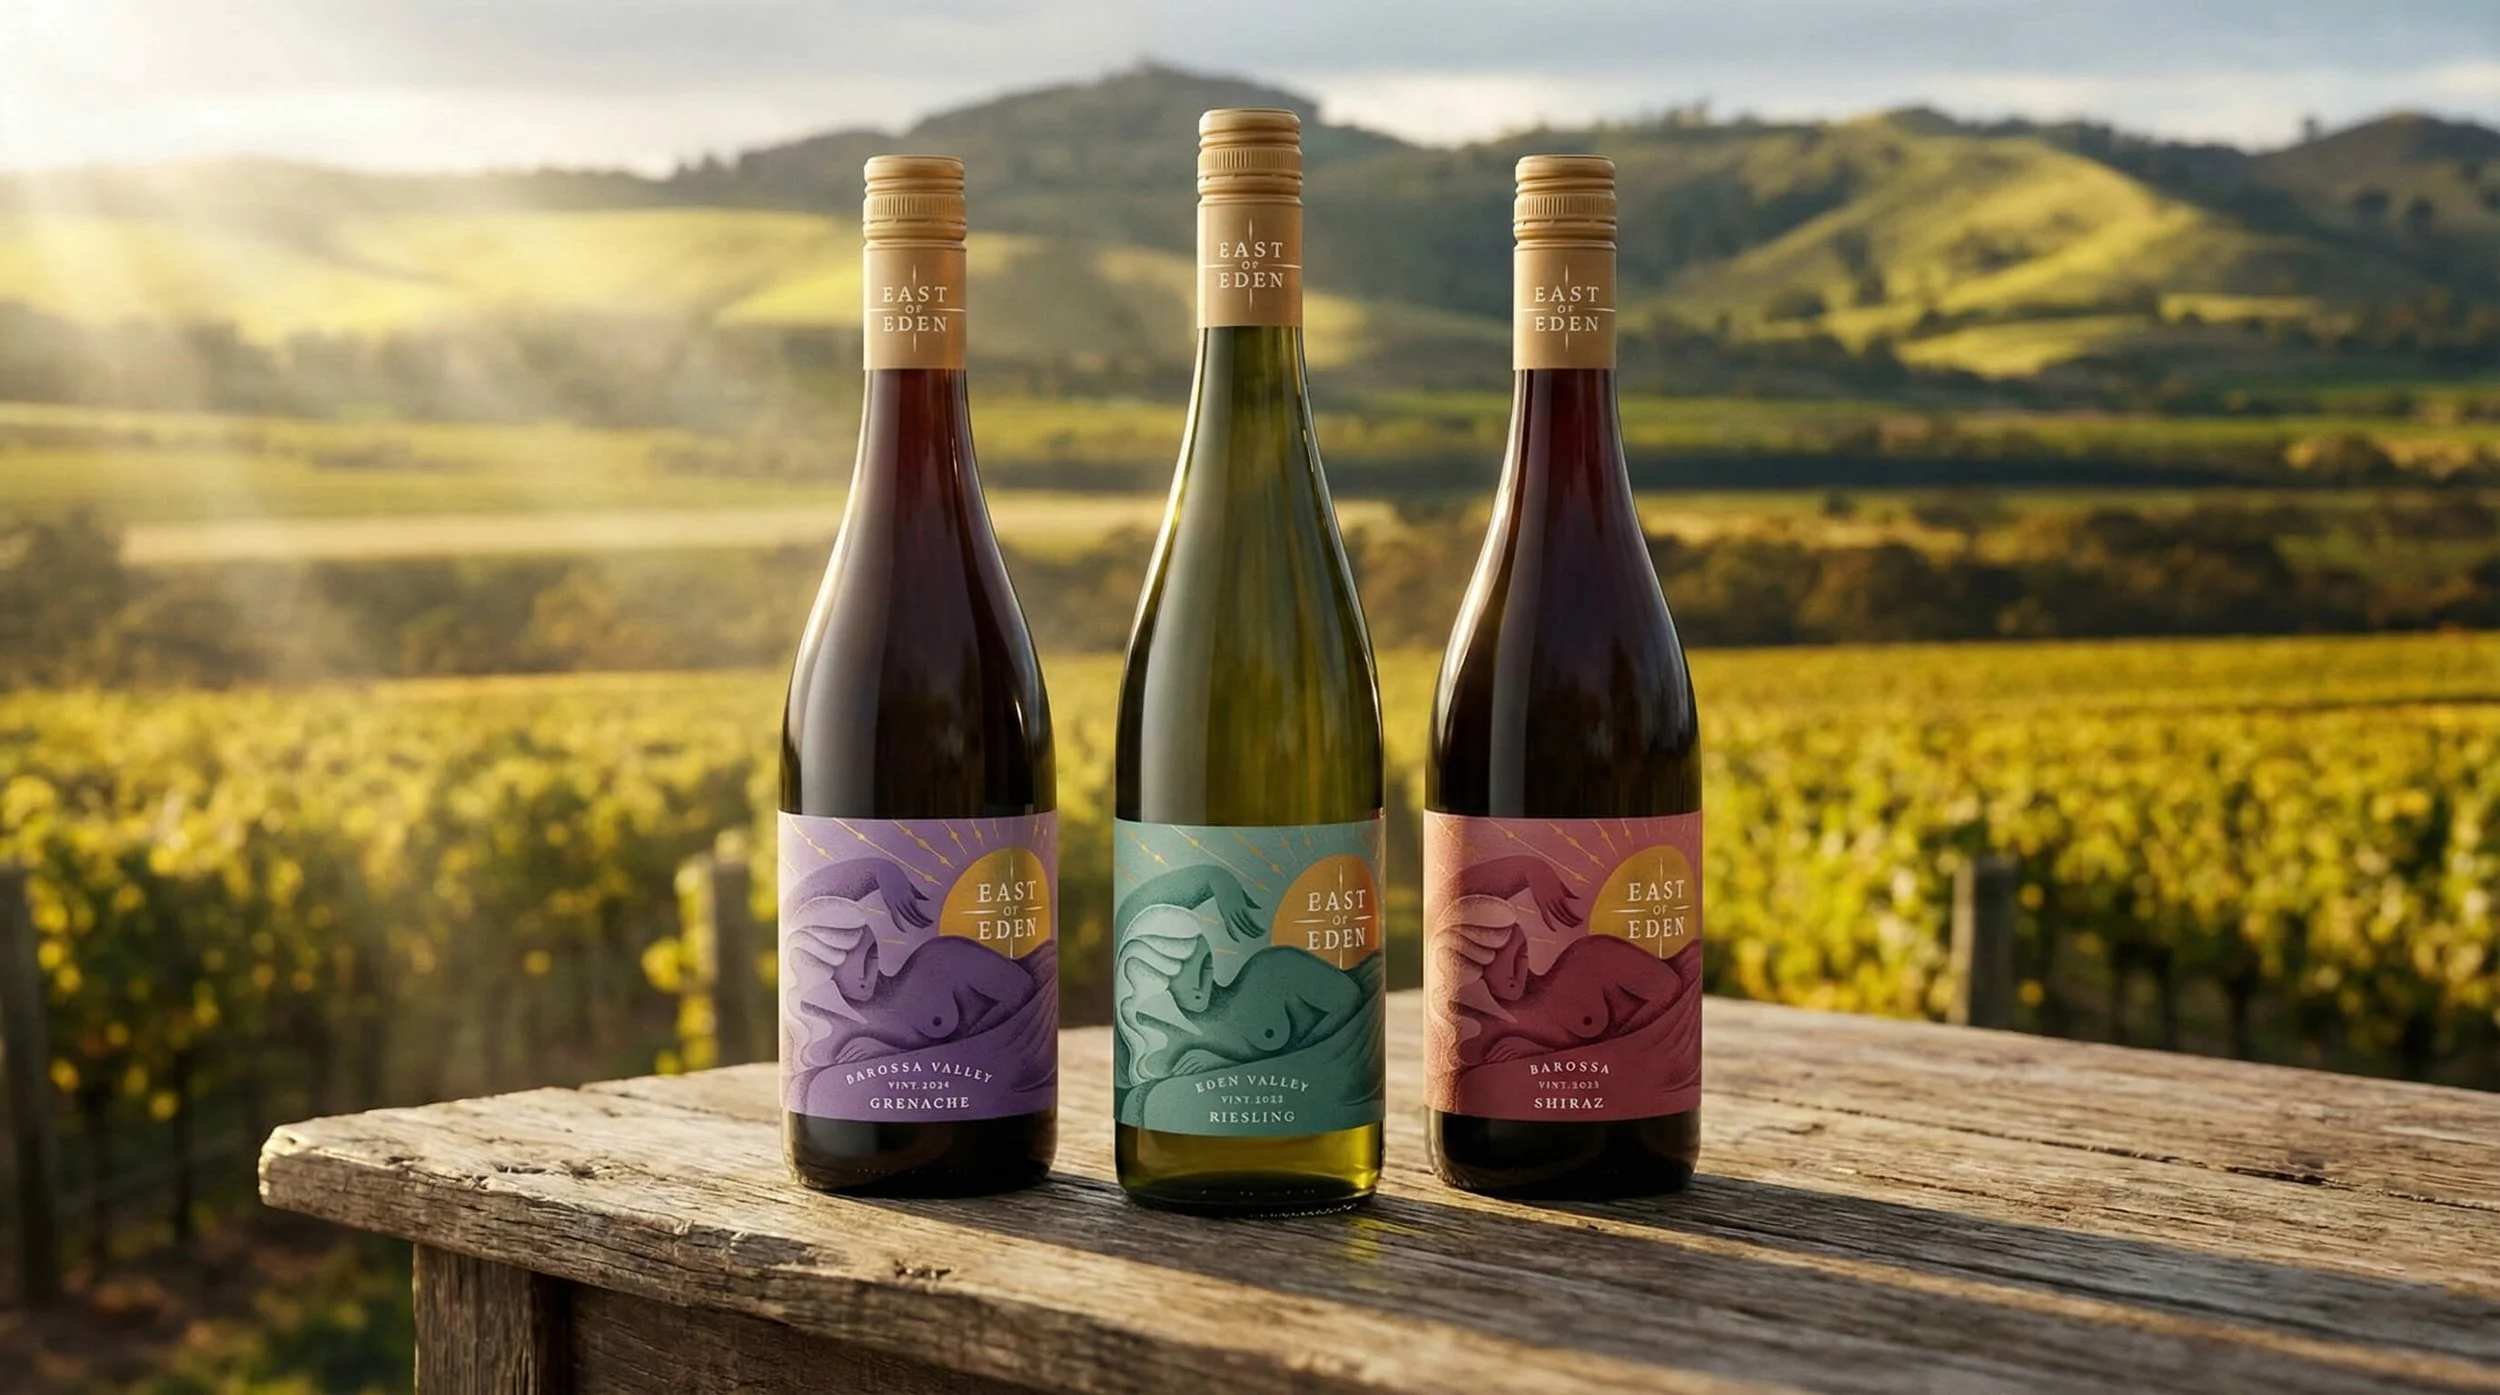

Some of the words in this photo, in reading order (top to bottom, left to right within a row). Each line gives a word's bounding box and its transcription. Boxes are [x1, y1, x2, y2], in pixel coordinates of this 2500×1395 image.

[1219, 241, 1283, 258] EAST
[1219, 272, 1284, 288] EDEN
[882, 285, 947, 303] EAST
[1534, 285, 1599, 303] EAST
[883, 316, 947, 332] EDEN
[1534, 316, 1599, 332] EDEN
[976, 880, 1037, 903] EAST
[1627, 879, 1685, 902] EAST
[1307, 889, 1366, 912] EAST
[977, 917, 1037, 940] EDEN
[1628, 916, 1685, 939] EDEN
[1306, 927, 1366, 951] EDEN
[846, 1061, 922, 1085] BAROSSA
[931, 1062, 992, 1083] VALLEY
[1529, 1061, 1609, 1075] BAROSSA
[1195, 1075, 1239, 1093] EDEN
[1247, 1074, 1309, 1092] VALLEY
[870, 1096, 970, 1110] GRENACHE
[1533, 1097, 1604, 1110] SHIRAZ
[1209, 1110, 1295, 1124] RIESLING
